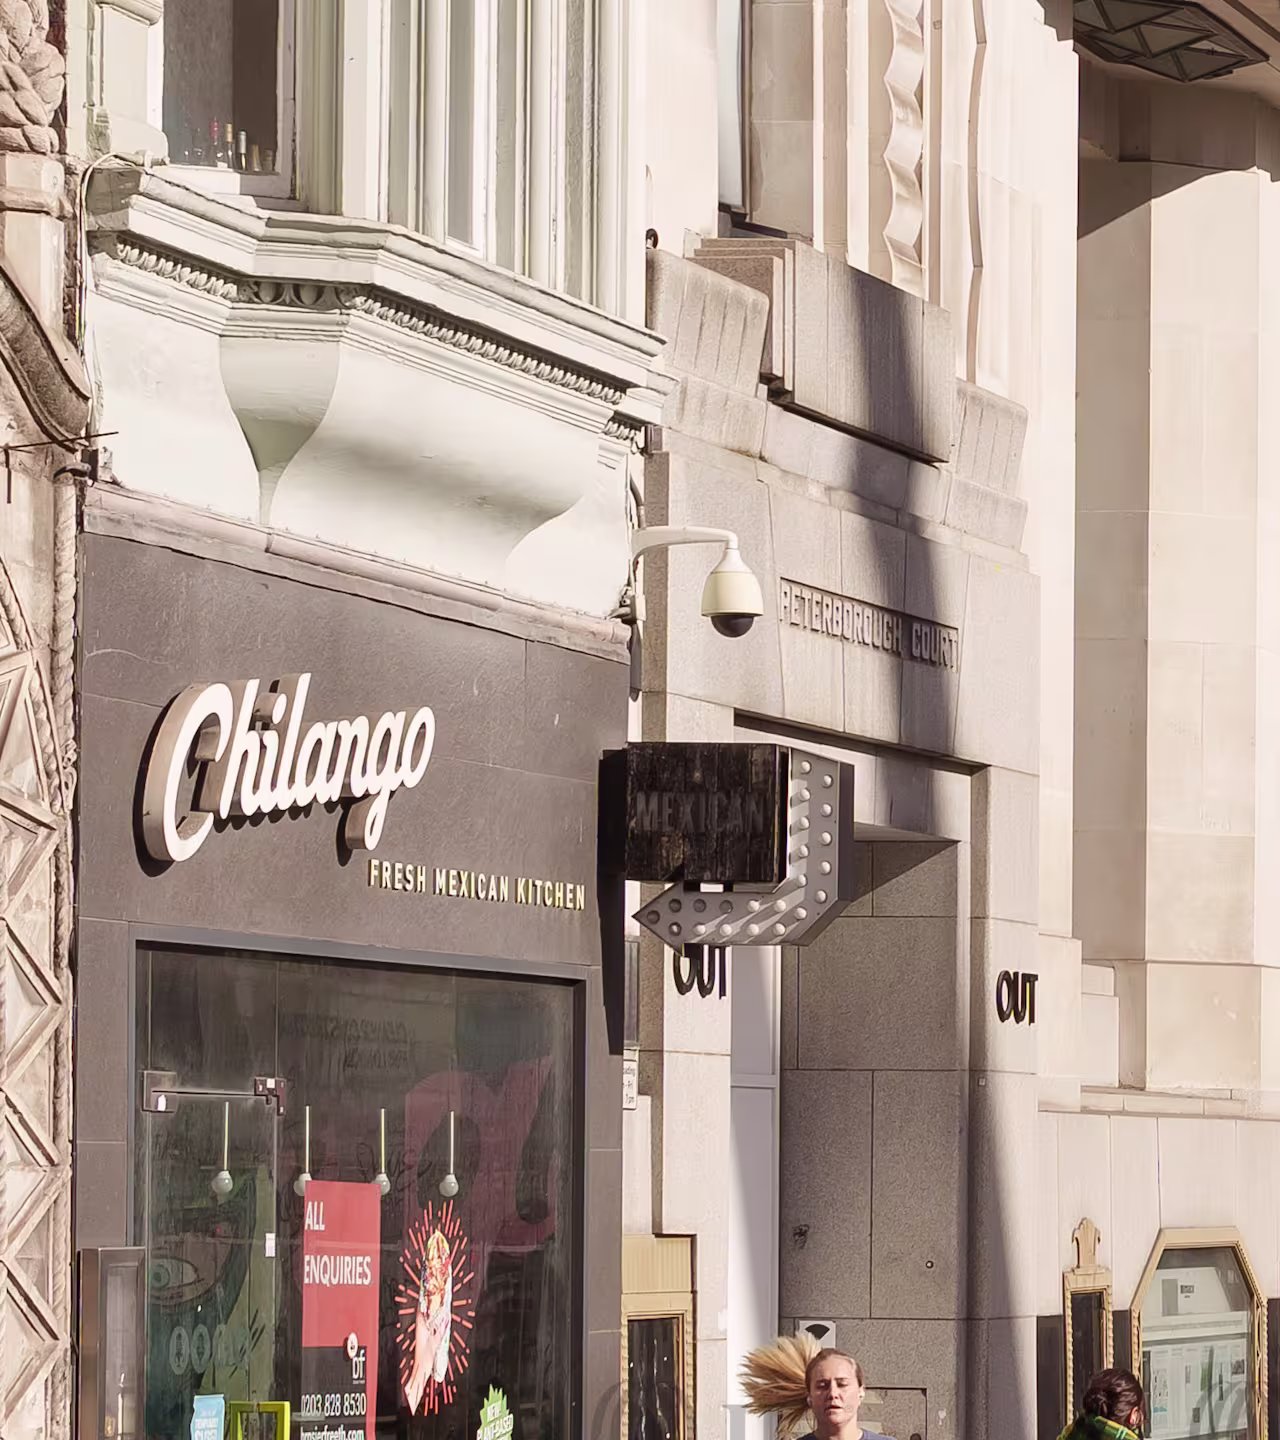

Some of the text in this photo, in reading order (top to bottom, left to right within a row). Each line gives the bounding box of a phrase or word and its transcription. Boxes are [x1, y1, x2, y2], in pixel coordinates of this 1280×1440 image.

[779, 580, 960, 673] PETERBOROUGH COURT
[158, 672, 436, 863] Chilango
[636, 791, 764, 832] MEXICAN
[370, 858, 585, 910] FRESH MEXICAN KITCHEN
[995, 970, 1038, 1026] OUT
[304, 1201, 325, 1231] ALL
[303, 1254, 372, 1288] ENQUIRIES
[301, 1392, 366, 1416] 0203 828 8530
